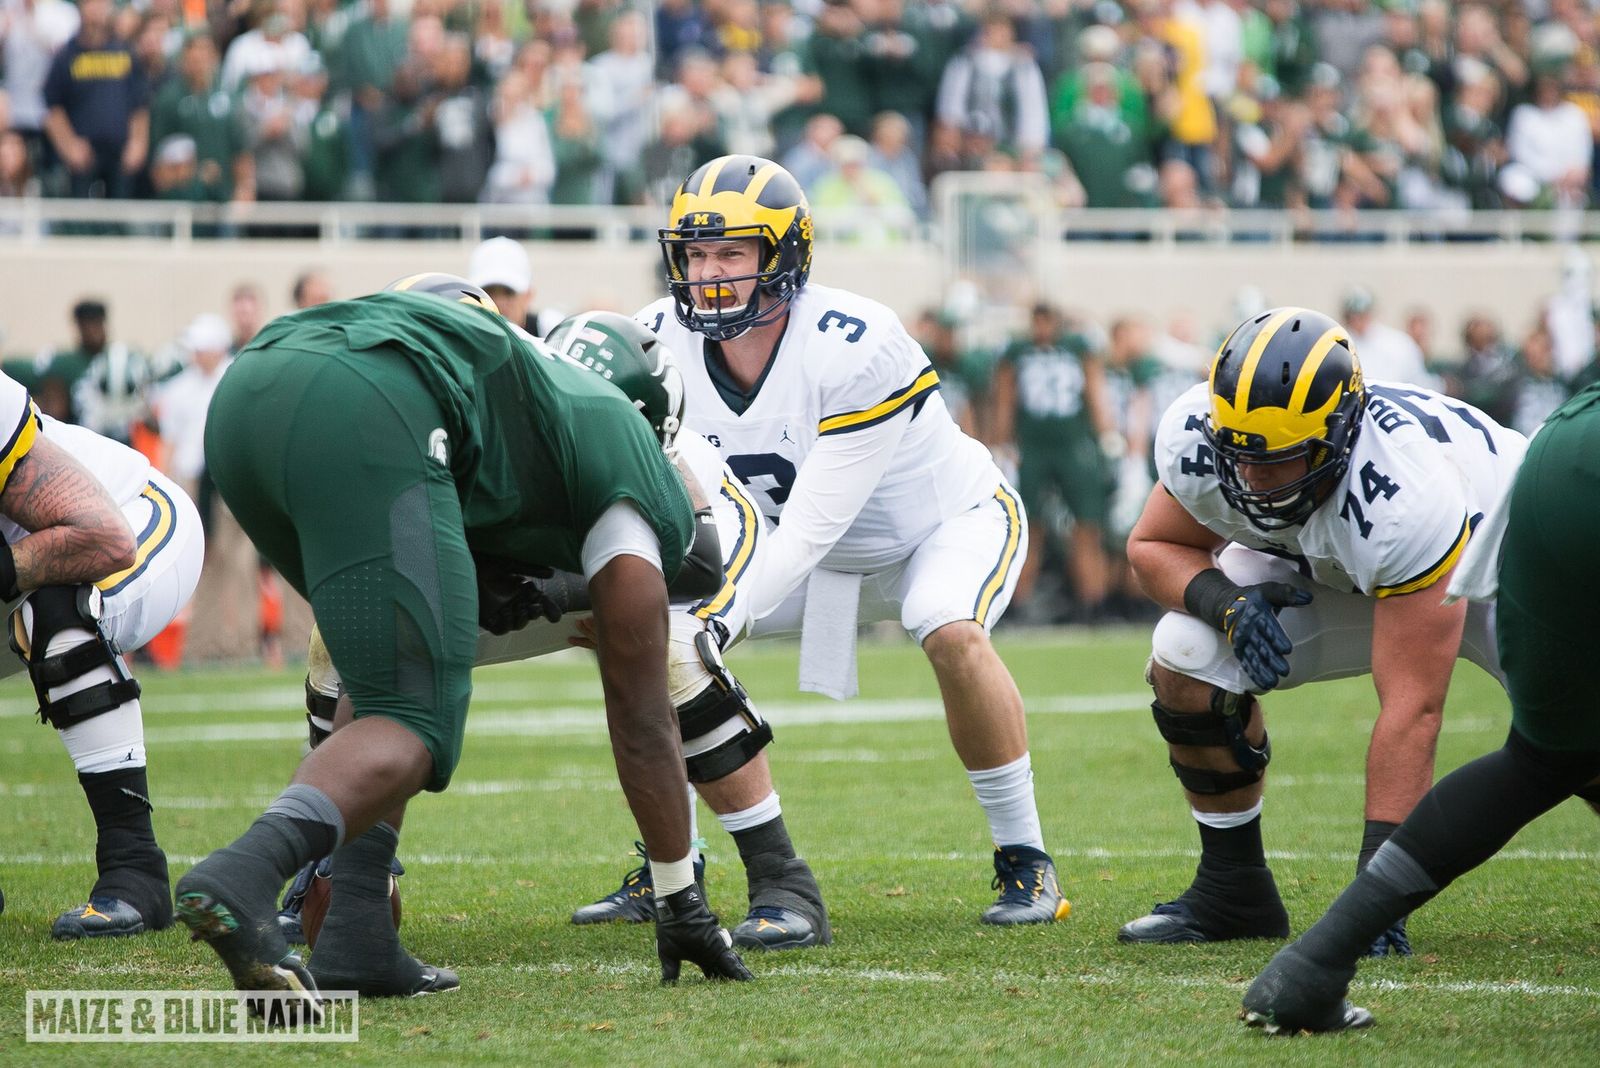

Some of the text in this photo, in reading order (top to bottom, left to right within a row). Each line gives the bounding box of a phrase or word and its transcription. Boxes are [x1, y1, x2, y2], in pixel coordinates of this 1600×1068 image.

[693, 213, 709, 226] M
[817, 309, 867, 344] 3
[1232, 432, 1248, 446] M
[1339, 460, 1401, 540] 74
